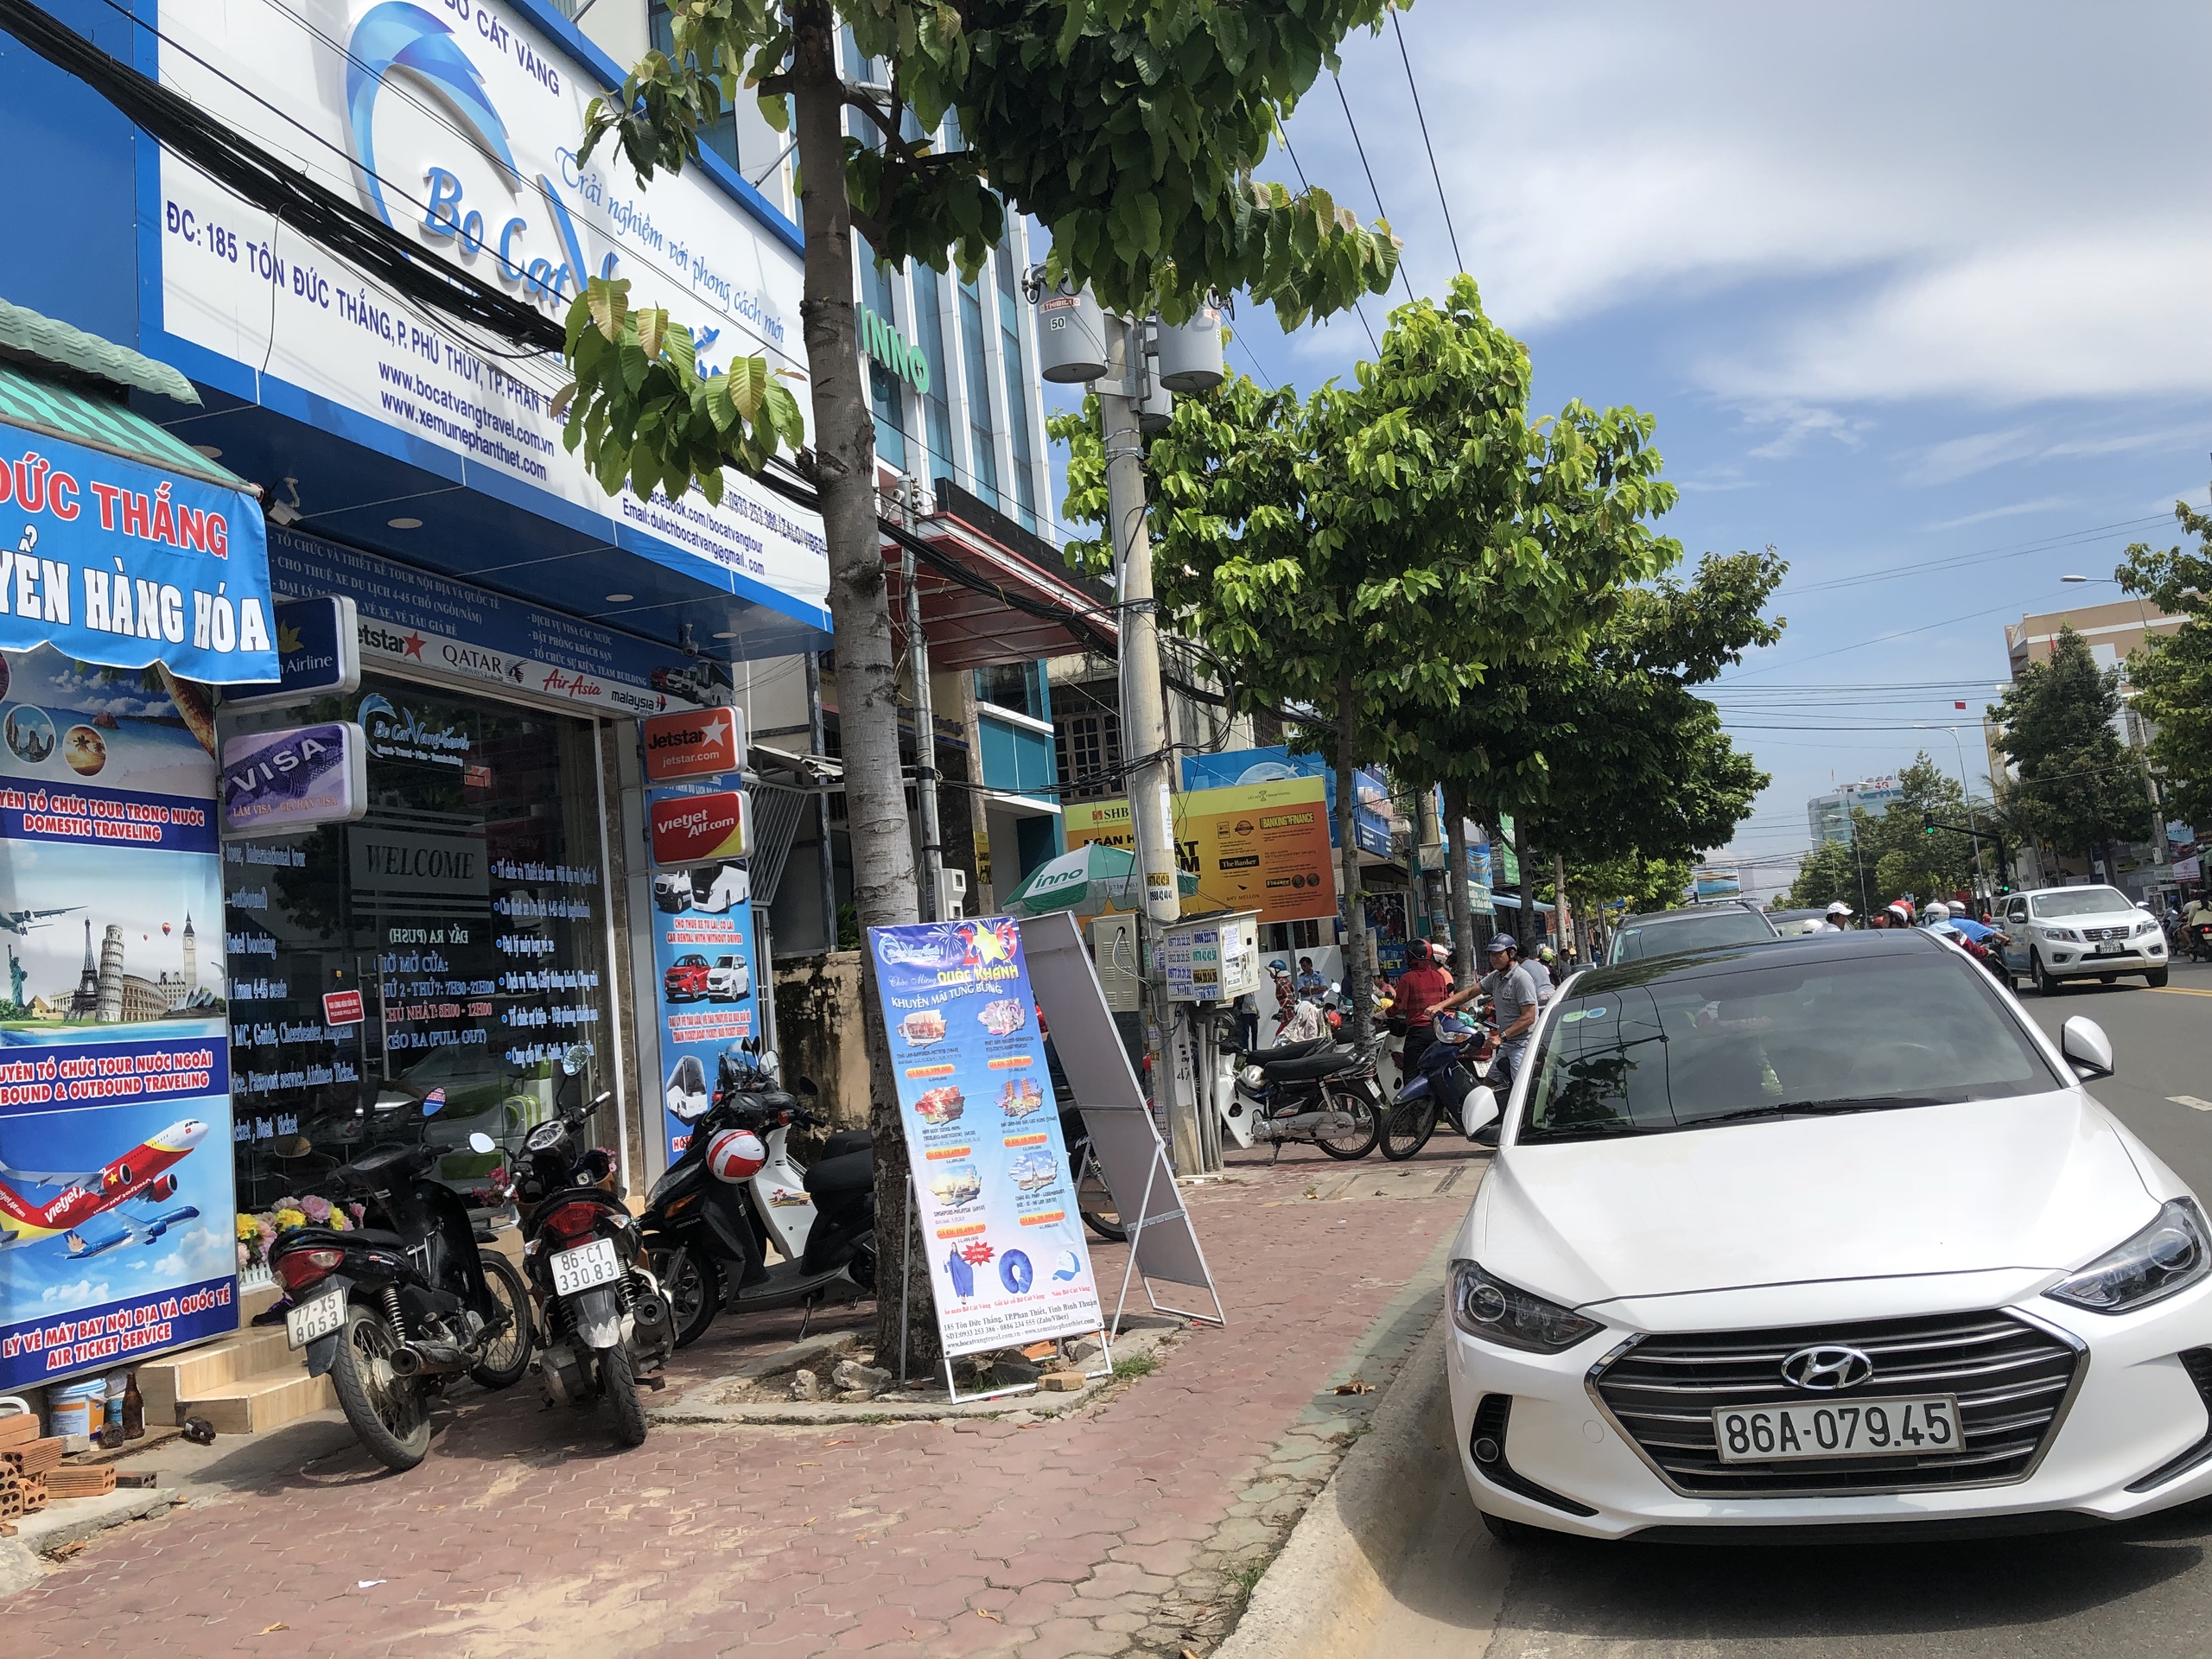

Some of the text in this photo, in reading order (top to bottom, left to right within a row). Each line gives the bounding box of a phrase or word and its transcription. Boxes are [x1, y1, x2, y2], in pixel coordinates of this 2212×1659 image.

[477, 10, 509, 54] CÁT
[515, 39, 559, 97] VÀNG
[608, 191, 663, 251] nghiệm
[669, 239, 688, 270] với
[692, 257, 731, 312] phong
[734, 289, 761, 327] cách
[764, 308, 785, 344] mới
[167, 200, 202, 247] ĐC:
[207, 223, 238, 264] 185
[247, 239, 285, 289] TÔN
[293, 262, 329, 310] ĐỨC
[336, 287, 395, 341] THẮNG,
[397, 320, 408, 349] P.
[412, 324, 441, 365] PHÚ
[1052, 317, 1065, 329] 50
[859, 302, 931, 394] INNO
[378, 360, 556, 458] www.bocatvangtravel.com.vn
[380, 390, 548, 482] www.xemuinephanthiet.com
[90, 480, 228, 560] THẮNG
[294, 538, 324, 557] CHỨC
[390, 567, 414, 585] TOUR
[277, 556, 302, 572] CHO
[304, 563, 334, 582] THUÊ
[335, 572, 348, 586] XE
[350, 576, 365, 591] DU
[367, 582, 390, 598] LỊCH
[392, 589, 410, 603] 4-45
[279, 579, 298, 596] ĐẠI
[83, 556, 185, 644] HÀNG
[193, 582, 270, 653] HÓA
[409, 613, 427, 628] TÀU
[429, 617, 444, 633] GIÁ
[531, 613, 550, 627] DỊCH
[563, 622, 579, 636] VISA
[579, 626, 593, 640] CÁC
[358, 624, 405, 654] etstar
[549, 635, 574, 651] PHÒNG
[575, 643, 599, 658] KHÁCH
[287, 654, 333, 676] Airline
[442, 645, 503, 674] QATAR
[545, 652, 647, 686] CHỨC TEAM BUILDING
[611, 690, 654, 710] malaysia
[649, 729, 705, 750] Jetstar
[232, 738, 327, 791] VISA
[662, 751, 720, 768] jetstar.com
[29, 789, 48, 811] TỔ
[51, 794, 86, 814] CHỨC
[89, 800, 124, 819] TOUR
[126, 804, 168, 823] TRONG
[172, 808, 204, 827] NƯỚC
[233, 804, 251, 817] LÀM
[253, 804, 272, 816] VISA
[280, 801, 296, 812] GIA
[317, 796, 338, 807] VISA
[1103, 807, 1129, 820] SHB
[1290, 812, 1313, 824] FINANCE
[23, 814, 162, 842] DOMESTIC TRAVELING
[366, 844, 475, 880] WELCOME
[1236, 858, 1257, 867] Banker
[1034, 868, 1084, 889] inno
[399, 950, 420, 973] MỞ
[975, 964, 1020, 981] KHÁNH
[399, 984, 406, 997] 2
[891, 995, 930, 1009] KHUYẾN
[438, 1003, 461, 1018] 8H00
[467, 1002, 493, 1017] 12H00
[387, 1028, 487, 1051] KÉO RA (PULL OUT)
[37, 1055, 56, 1079] TỔ
[60, 1056, 96, 1077] CHỨC
[99, 1056, 133, 1075] TOUR
[137, 1052, 171, 1072] NƯỚC
[174, 1048, 213, 1069] NGOÀI
[54, 1084, 67, 1100] &
[70, 1077, 142, 1099] OUTBOUND
[144, 1071, 209, 1093] TRAVELING
[562, 1248, 606, 1271] 86-C1
[560, 1262, 615, 1292] 330.83
[3, 1282, 232, 1358] LÝ VÉ MÁY BAY NỘI ĐỊA VÀ QUỐC TẾ
[294, 1296, 336, 1325] 77-X5
[944, 1323, 955, 1332] 185
[955, 1320, 968, 1330] Tôn
[1078, 1299, 1098, 1311] Thuận
[296, 1313, 339, 1342] 8053
[974, 1326, 985, 1335] 253
[1000, 1322, 1014, 1332] 0886
[1014, 1320, 1025, 1329] 234
[1025, 1319, 1035, 1327] 555
[47, 1322, 172, 1371] AIR TICKET SERVICE
[1726, 1402, 1952, 1455] 86A-079.45
